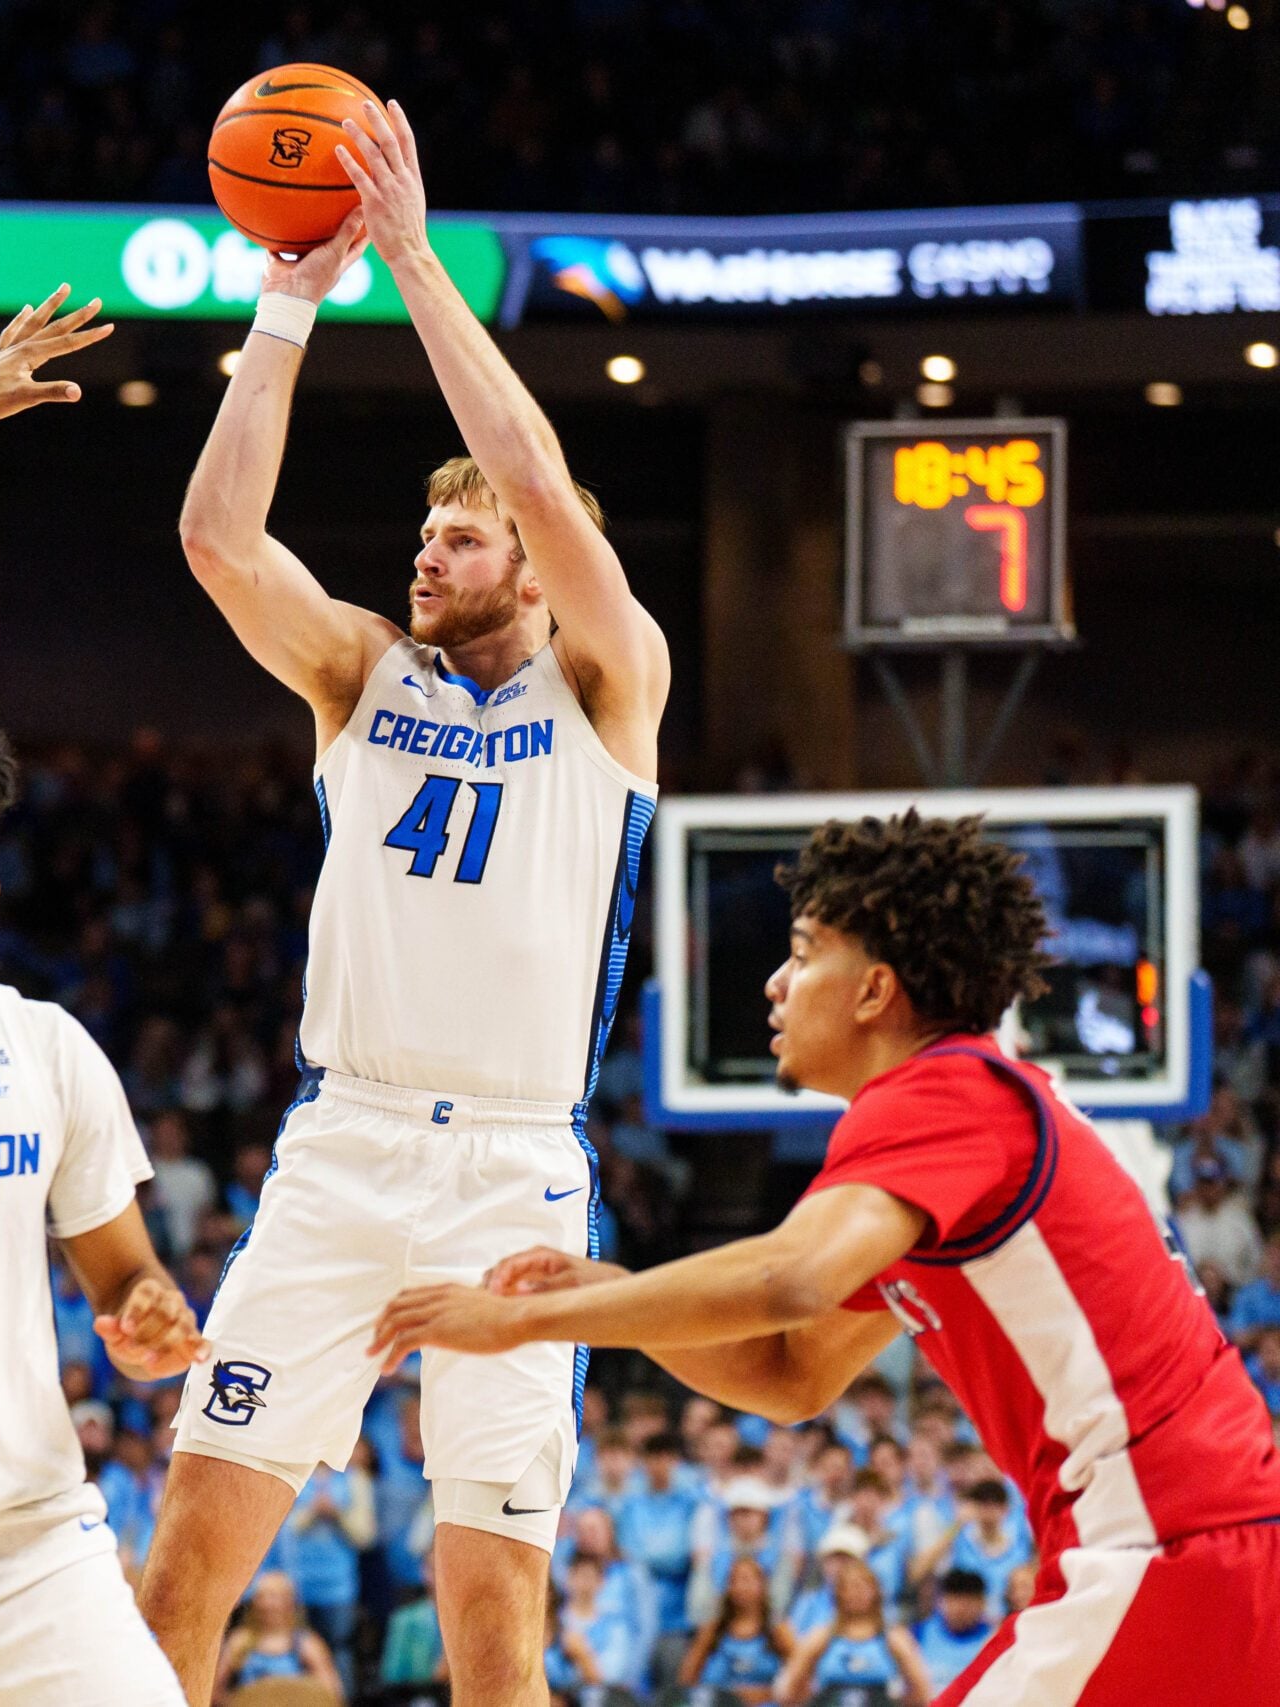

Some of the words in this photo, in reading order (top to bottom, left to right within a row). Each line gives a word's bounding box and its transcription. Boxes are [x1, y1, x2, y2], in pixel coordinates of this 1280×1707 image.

[964, 504, 1028, 612] 7
[367, 709, 554, 769] CREIGHTON
[383, 773, 504, 885] 41
[431, 1100, 454, 1125] C
